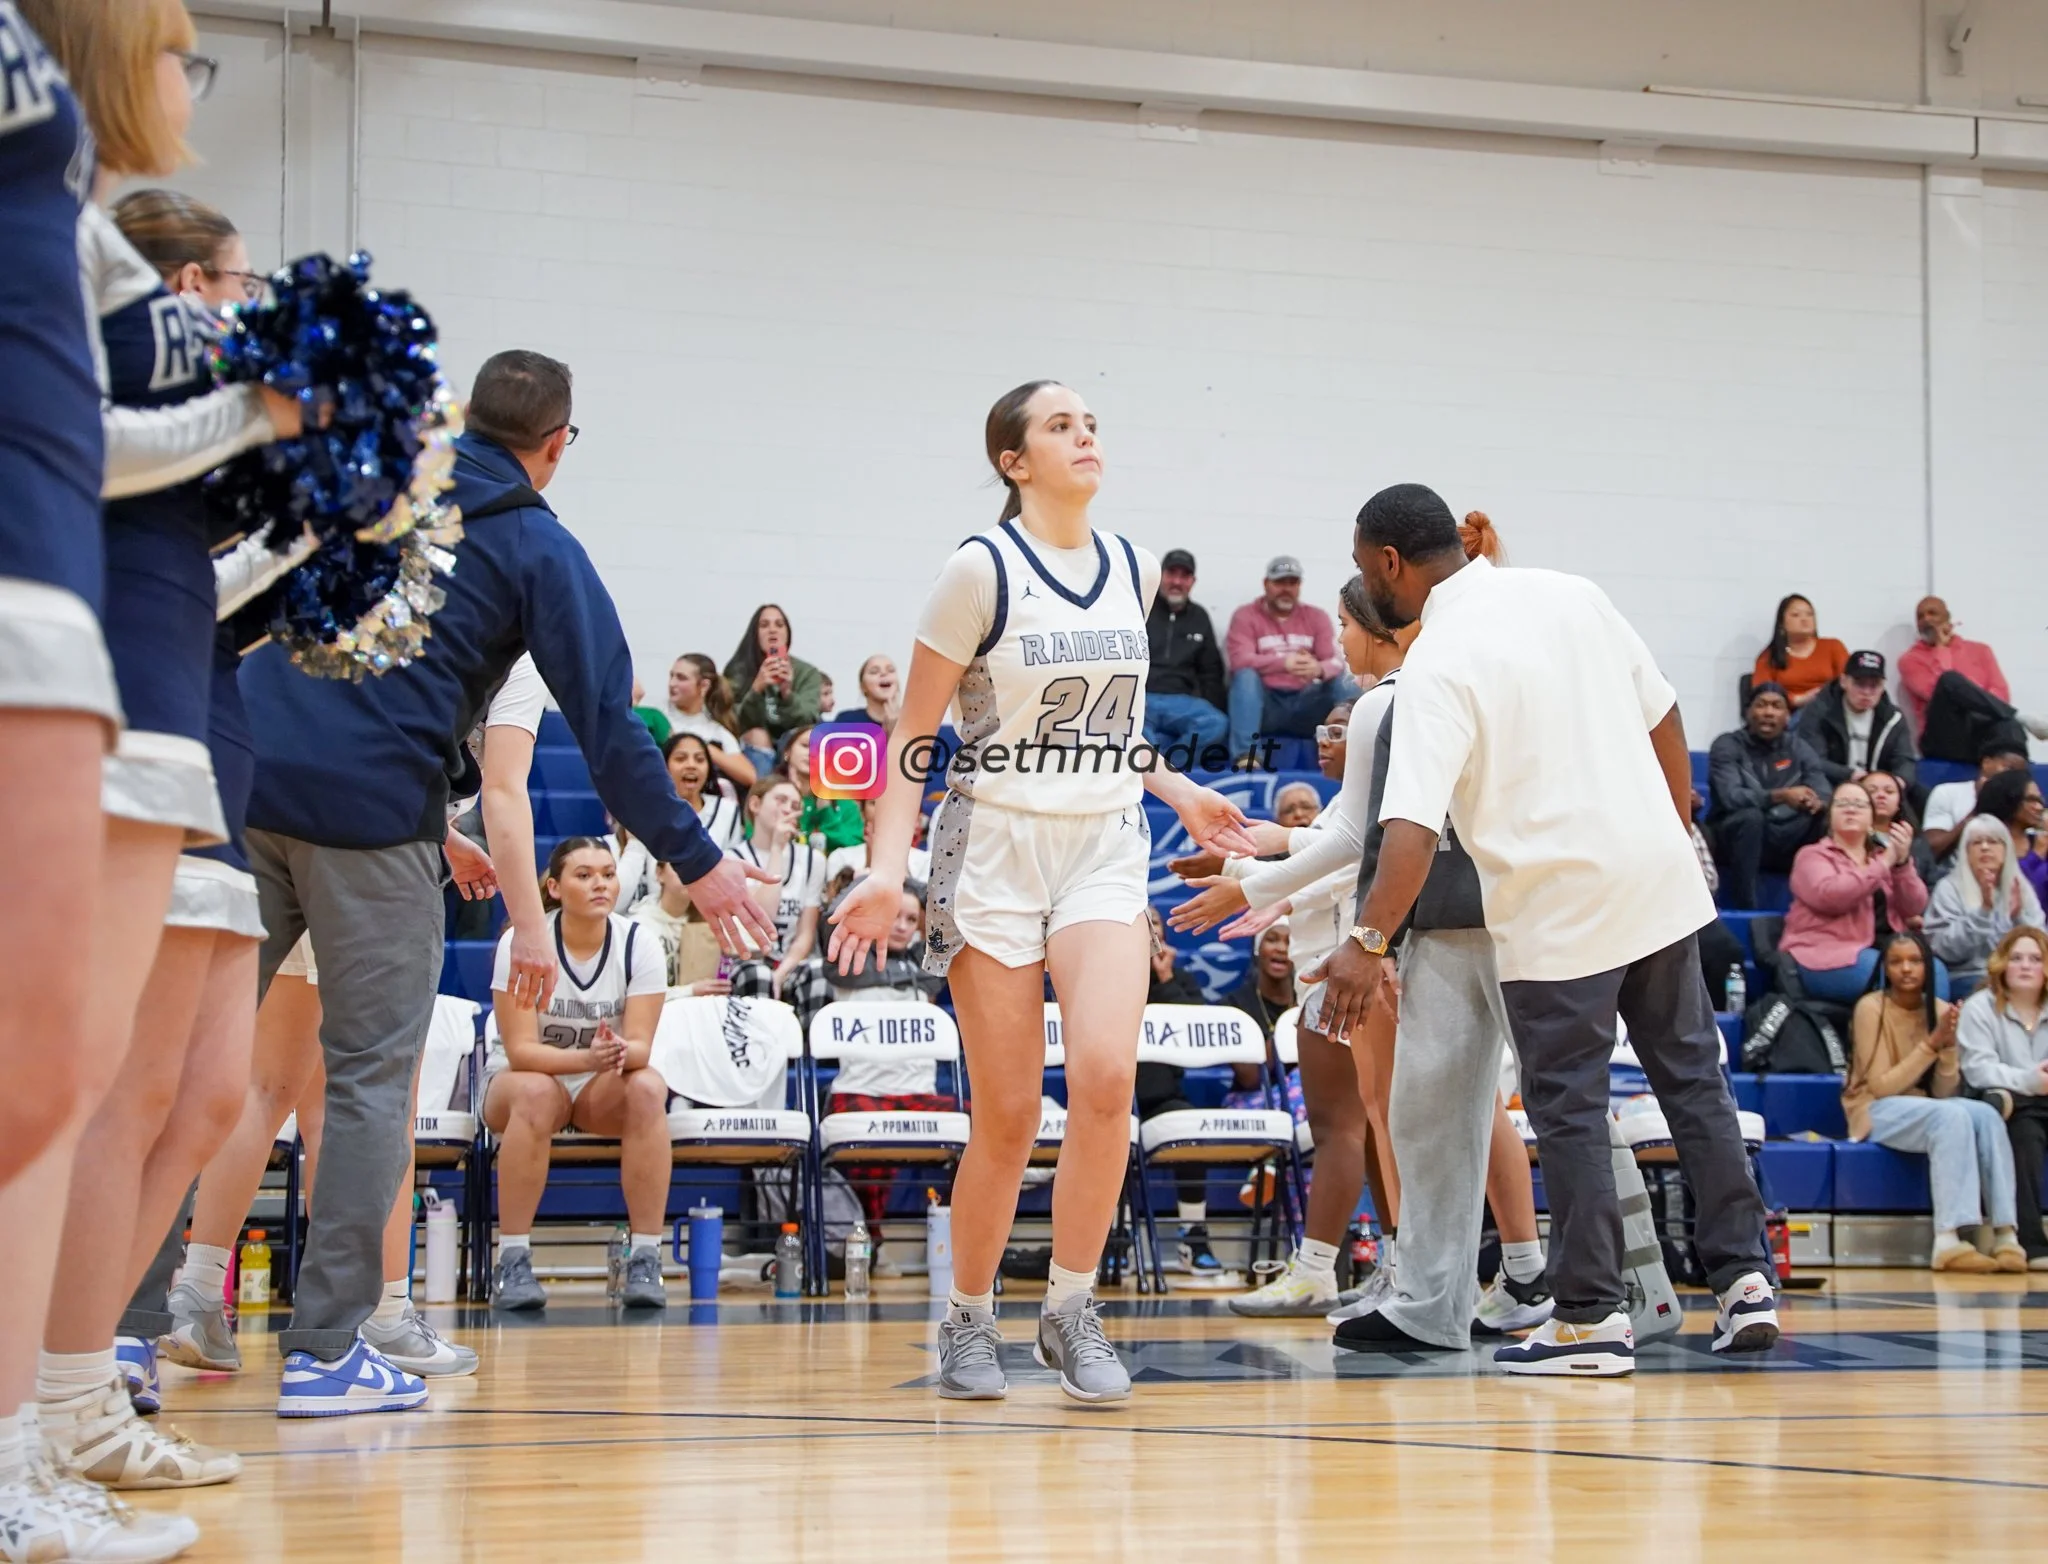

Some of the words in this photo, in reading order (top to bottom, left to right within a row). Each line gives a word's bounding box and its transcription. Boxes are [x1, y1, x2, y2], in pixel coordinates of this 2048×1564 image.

[1031, 674, 1139, 751] 24
[831, 1016, 936, 1044] RAIDERS
[1143, 1021, 1242, 1048] RAIDERS
[703, 1117, 778, 1132] APPOMATTOX
[867, 1119, 939, 1134] APPOMATTOX
